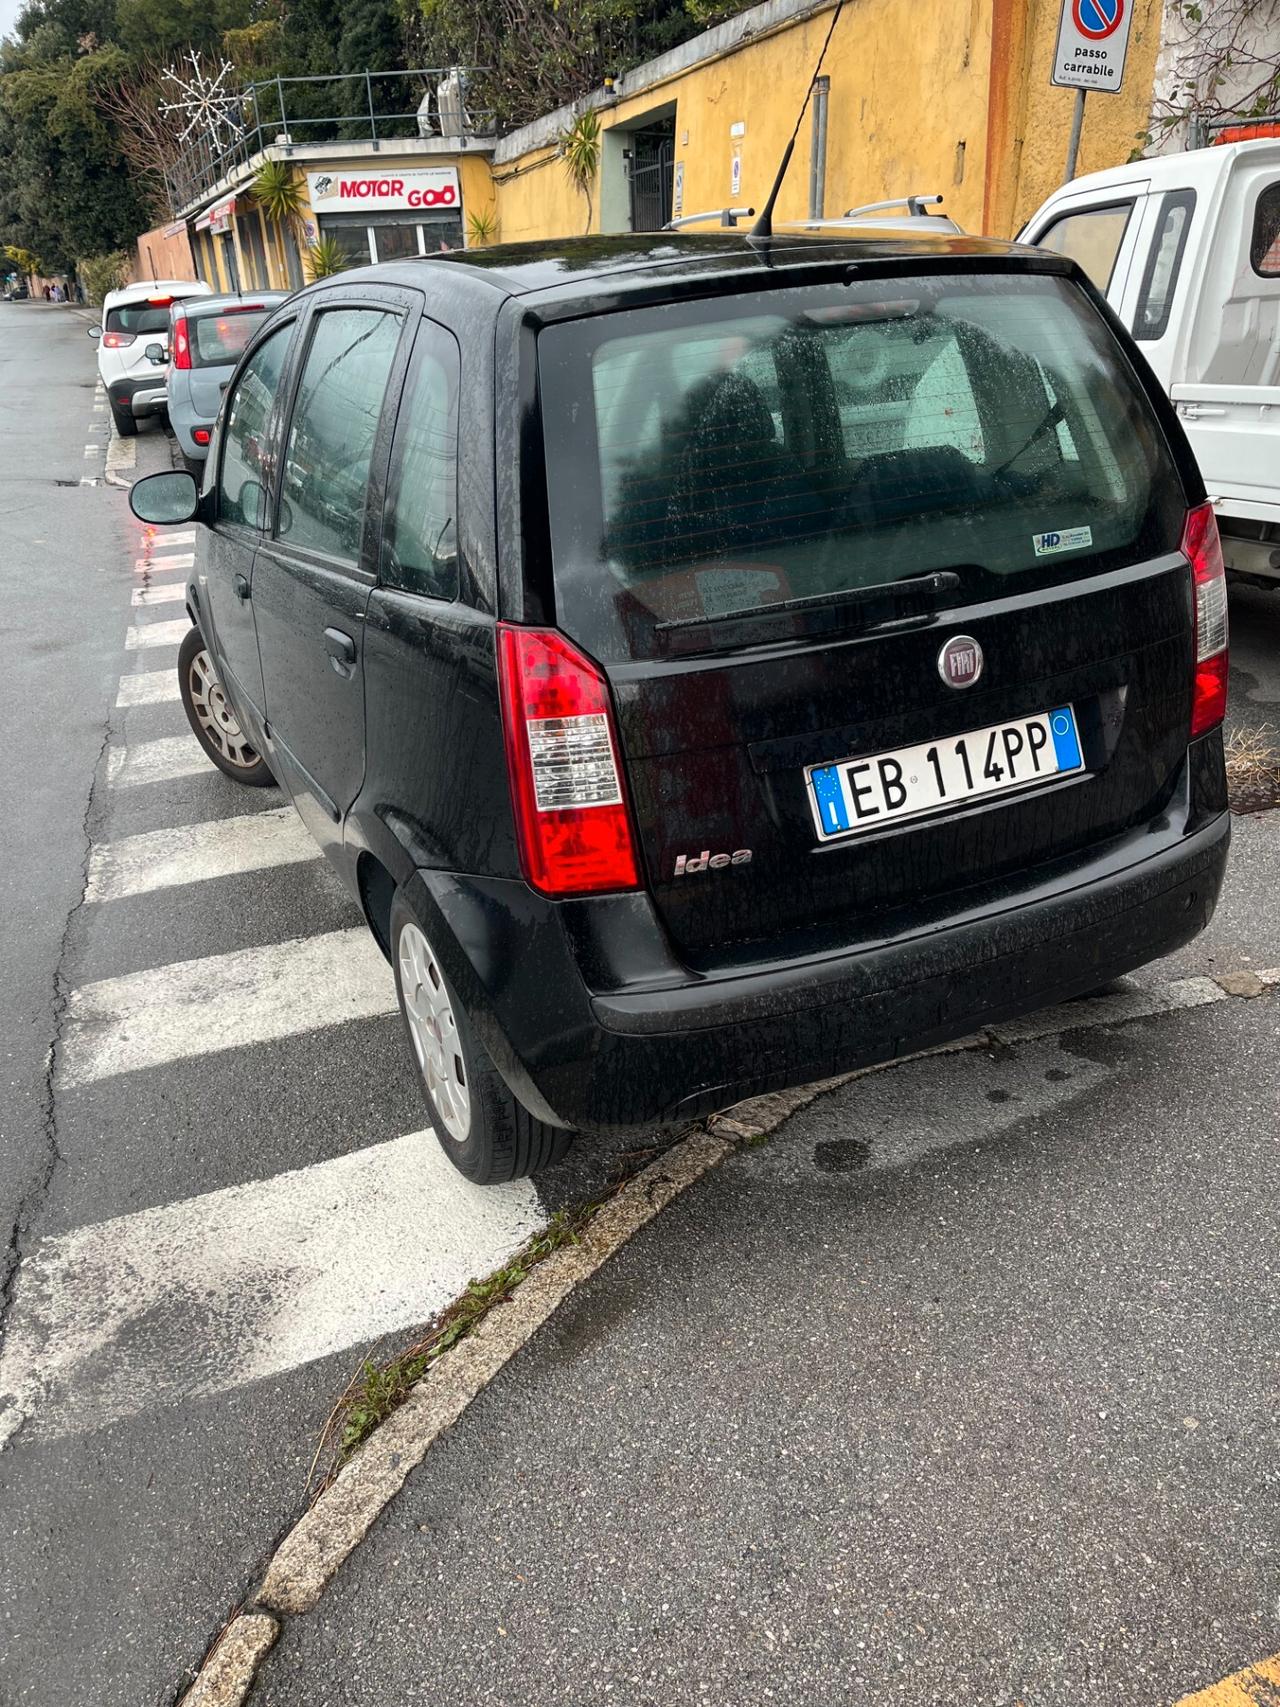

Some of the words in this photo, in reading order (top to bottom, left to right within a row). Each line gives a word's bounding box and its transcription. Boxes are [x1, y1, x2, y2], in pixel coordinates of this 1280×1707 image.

[1074, 47, 1108, 60] passo
[1063, 62, 1114, 77] carrabile
[340, 179, 404, 198] MOTOR
[1041, 533, 1060, 549] HD
[950, 649, 975, 678] FIAT
[846, 758, 907, 819] EB
[926, 721, 1047, 798] 114PP
[674, 849, 753, 876] Idea
